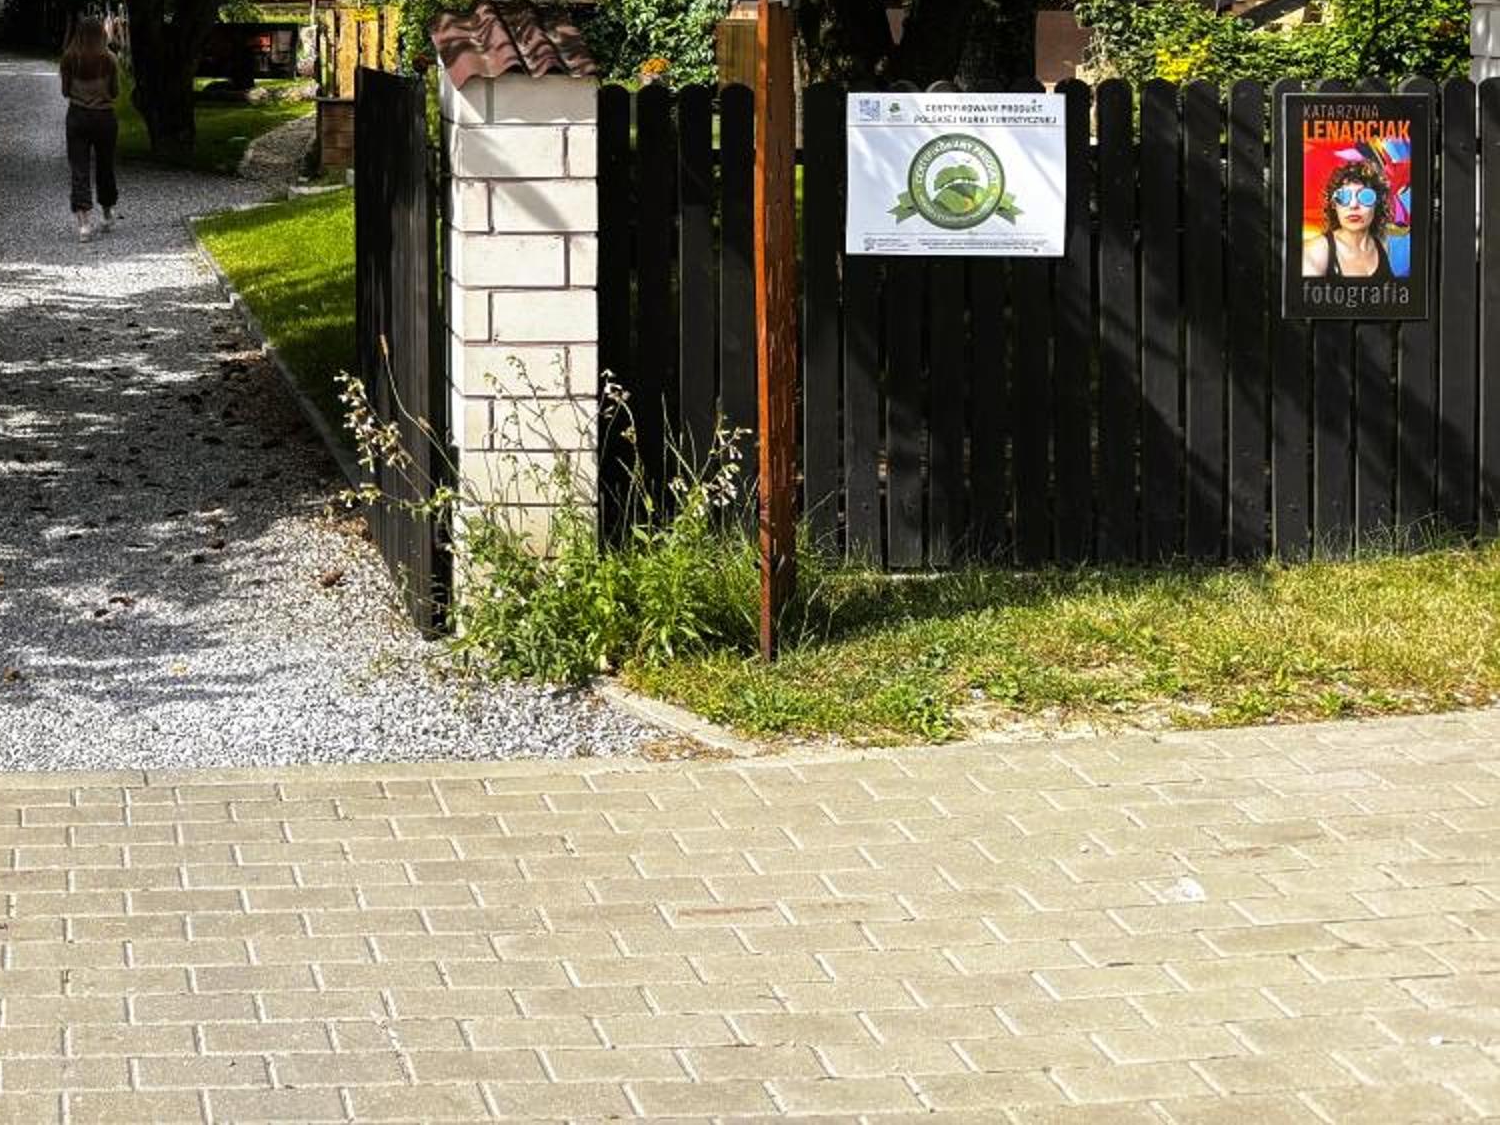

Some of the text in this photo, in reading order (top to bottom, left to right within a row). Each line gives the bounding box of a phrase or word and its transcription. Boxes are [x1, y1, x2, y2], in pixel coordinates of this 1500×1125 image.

[1303, 104, 1379, 118] KATARZYNA
[1303, 120, 1411, 140] LENARCIAK
[1303, 283, 1409, 307] fotografia
